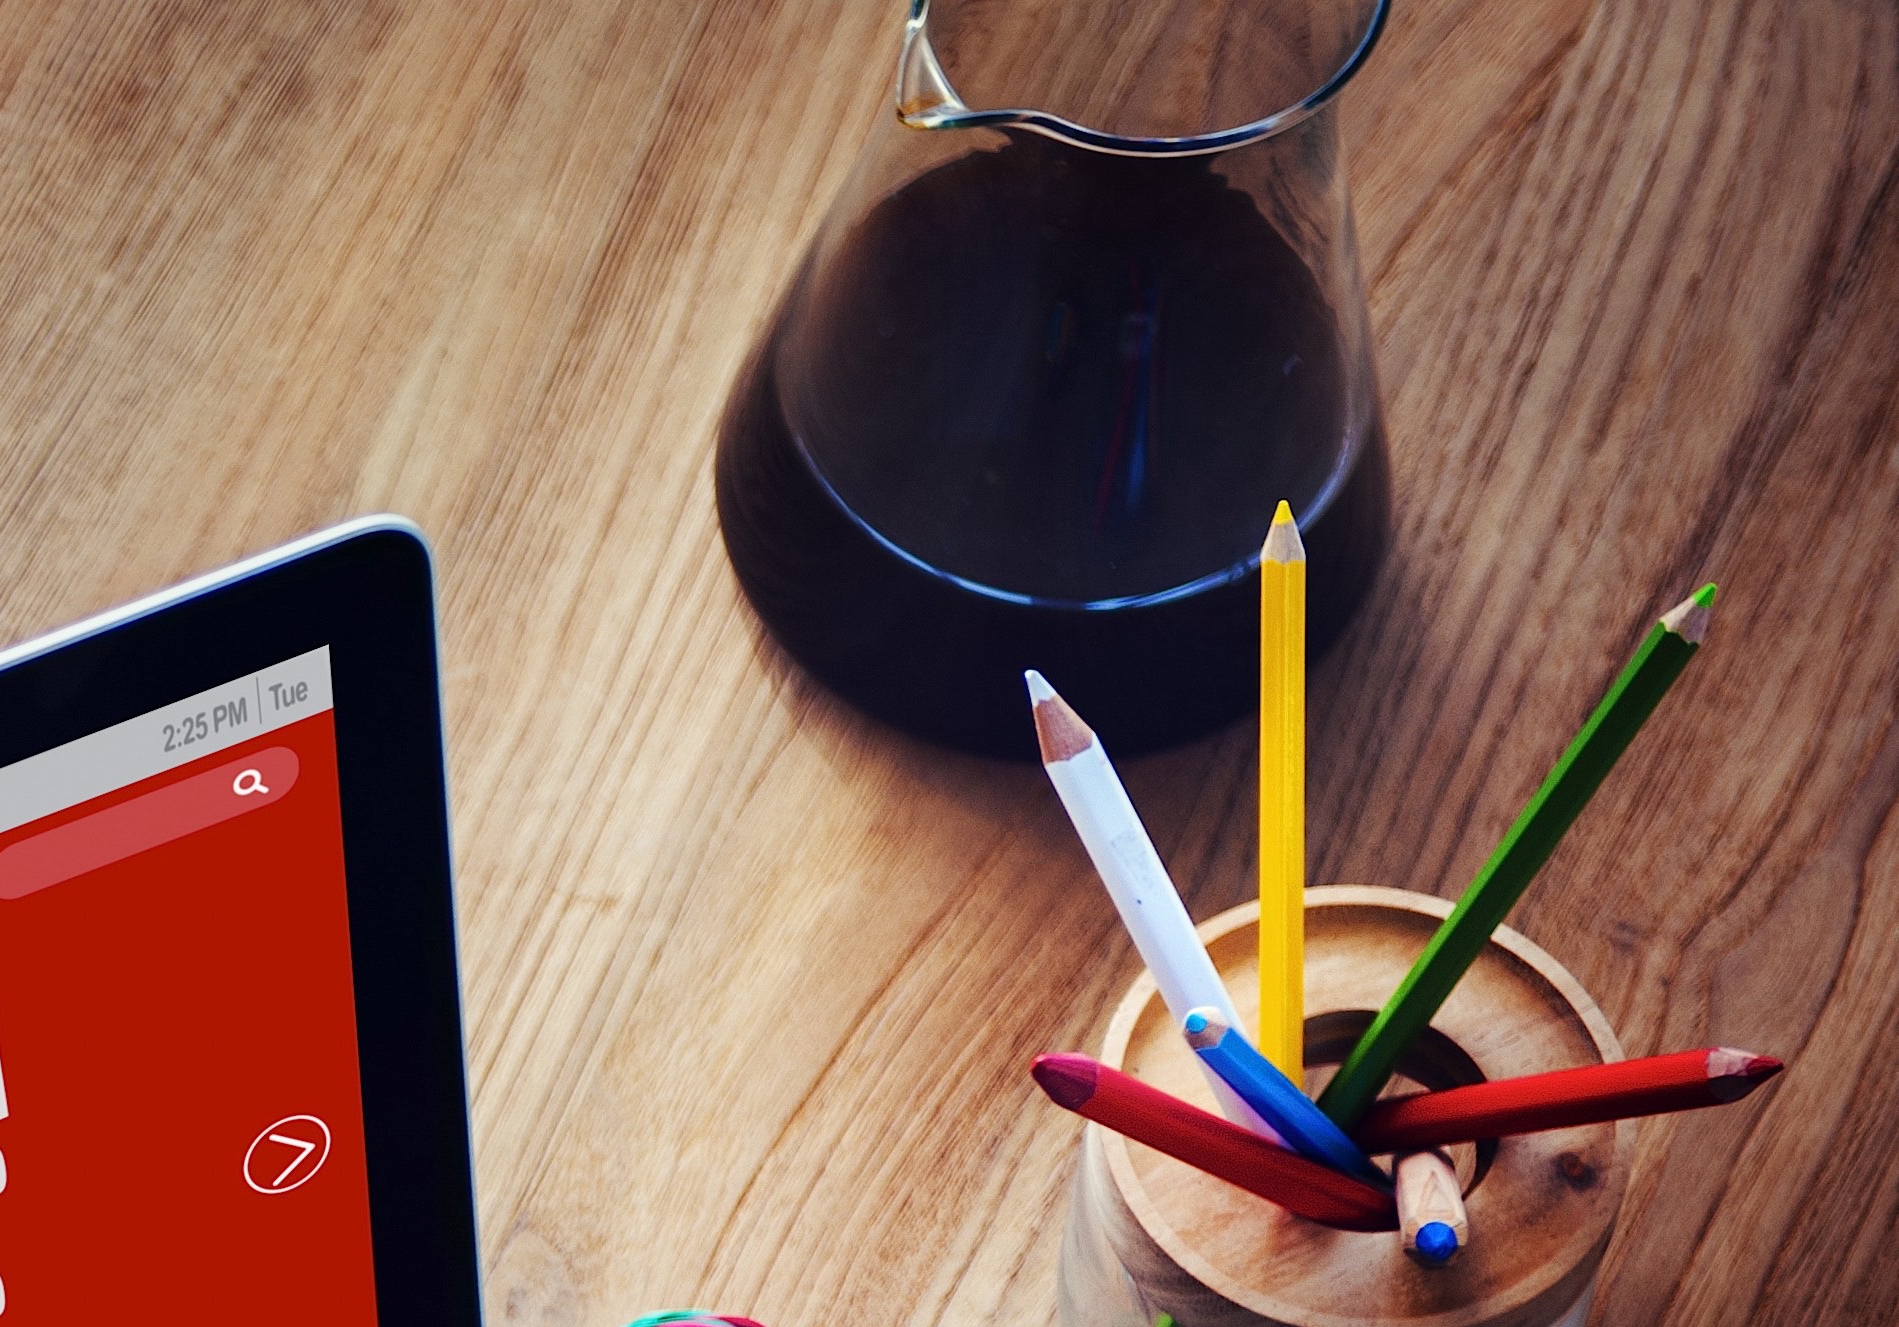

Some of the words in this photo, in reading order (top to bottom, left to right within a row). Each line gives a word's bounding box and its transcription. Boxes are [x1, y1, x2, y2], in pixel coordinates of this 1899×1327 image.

[267, 676, 310, 712] Tue
[162, 711, 210, 753] 2:25
[213, 696, 248, 735] PM
